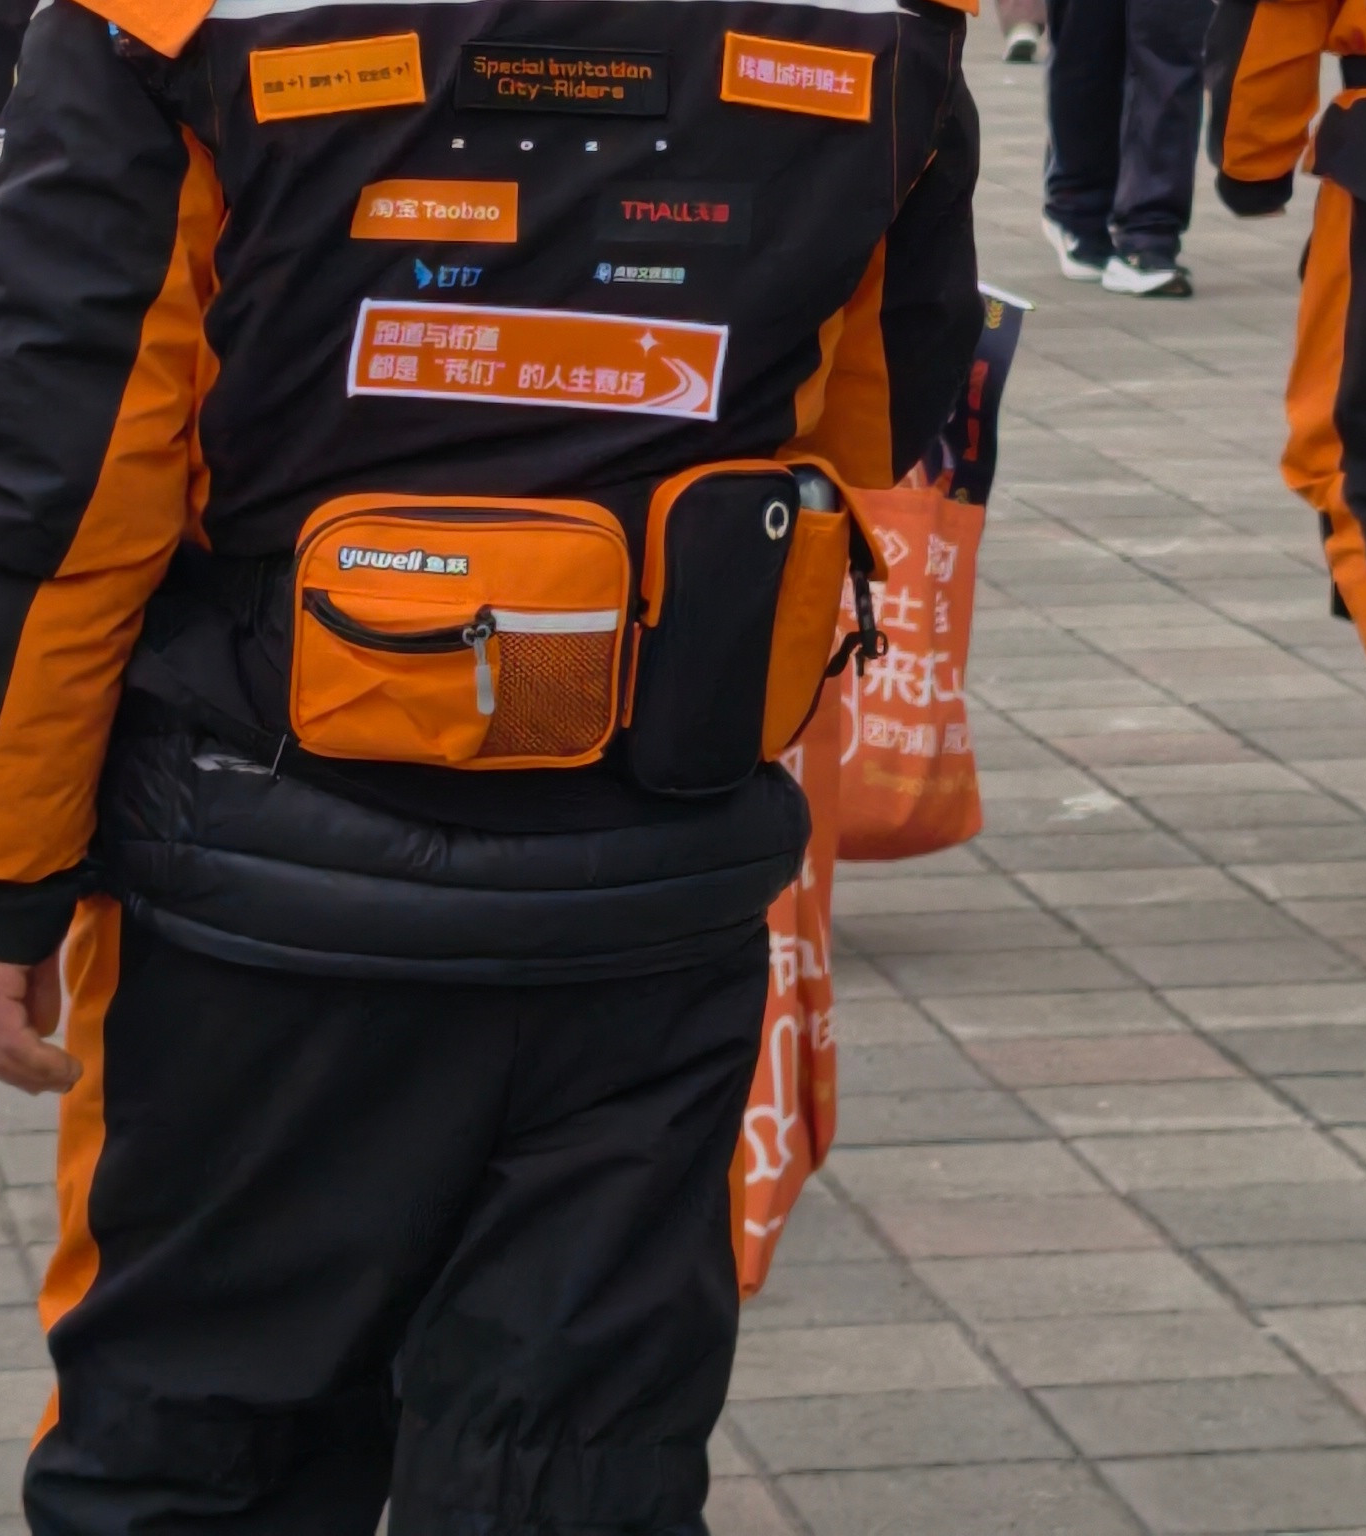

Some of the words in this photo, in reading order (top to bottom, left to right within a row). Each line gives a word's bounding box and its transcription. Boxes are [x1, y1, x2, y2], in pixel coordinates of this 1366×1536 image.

[472, 55, 545, 80] Special
[548, 57, 654, 80] Invitation
[369, 198, 418, 220] 淘宝
[421, 199, 501, 222] Taobao
[372, 320, 500, 352] 跑道与街道
[368, 353, 418, 382] 都是
[518, 363, 646, 398] 的人生赛场
[339, 545, 423, 572] yuwell
